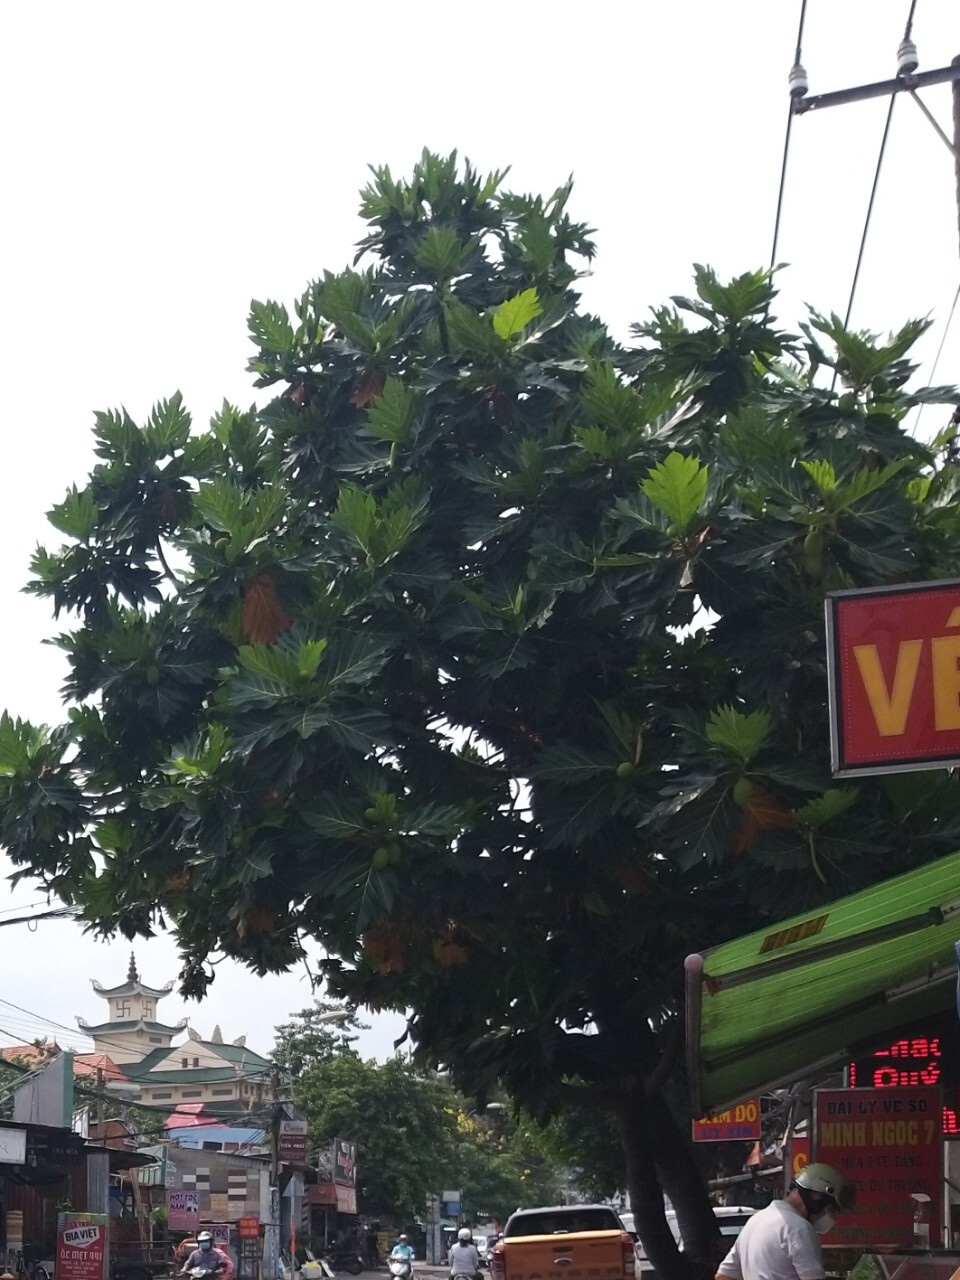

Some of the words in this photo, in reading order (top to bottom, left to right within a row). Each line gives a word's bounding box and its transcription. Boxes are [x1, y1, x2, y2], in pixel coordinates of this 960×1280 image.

[821, 1120, 866, 1148] MINH
[872, 1118, 919, 1150] NGỌC
[924, 1119, 936, 1145] 7
[65, 1230, 80, 1242] BIA
